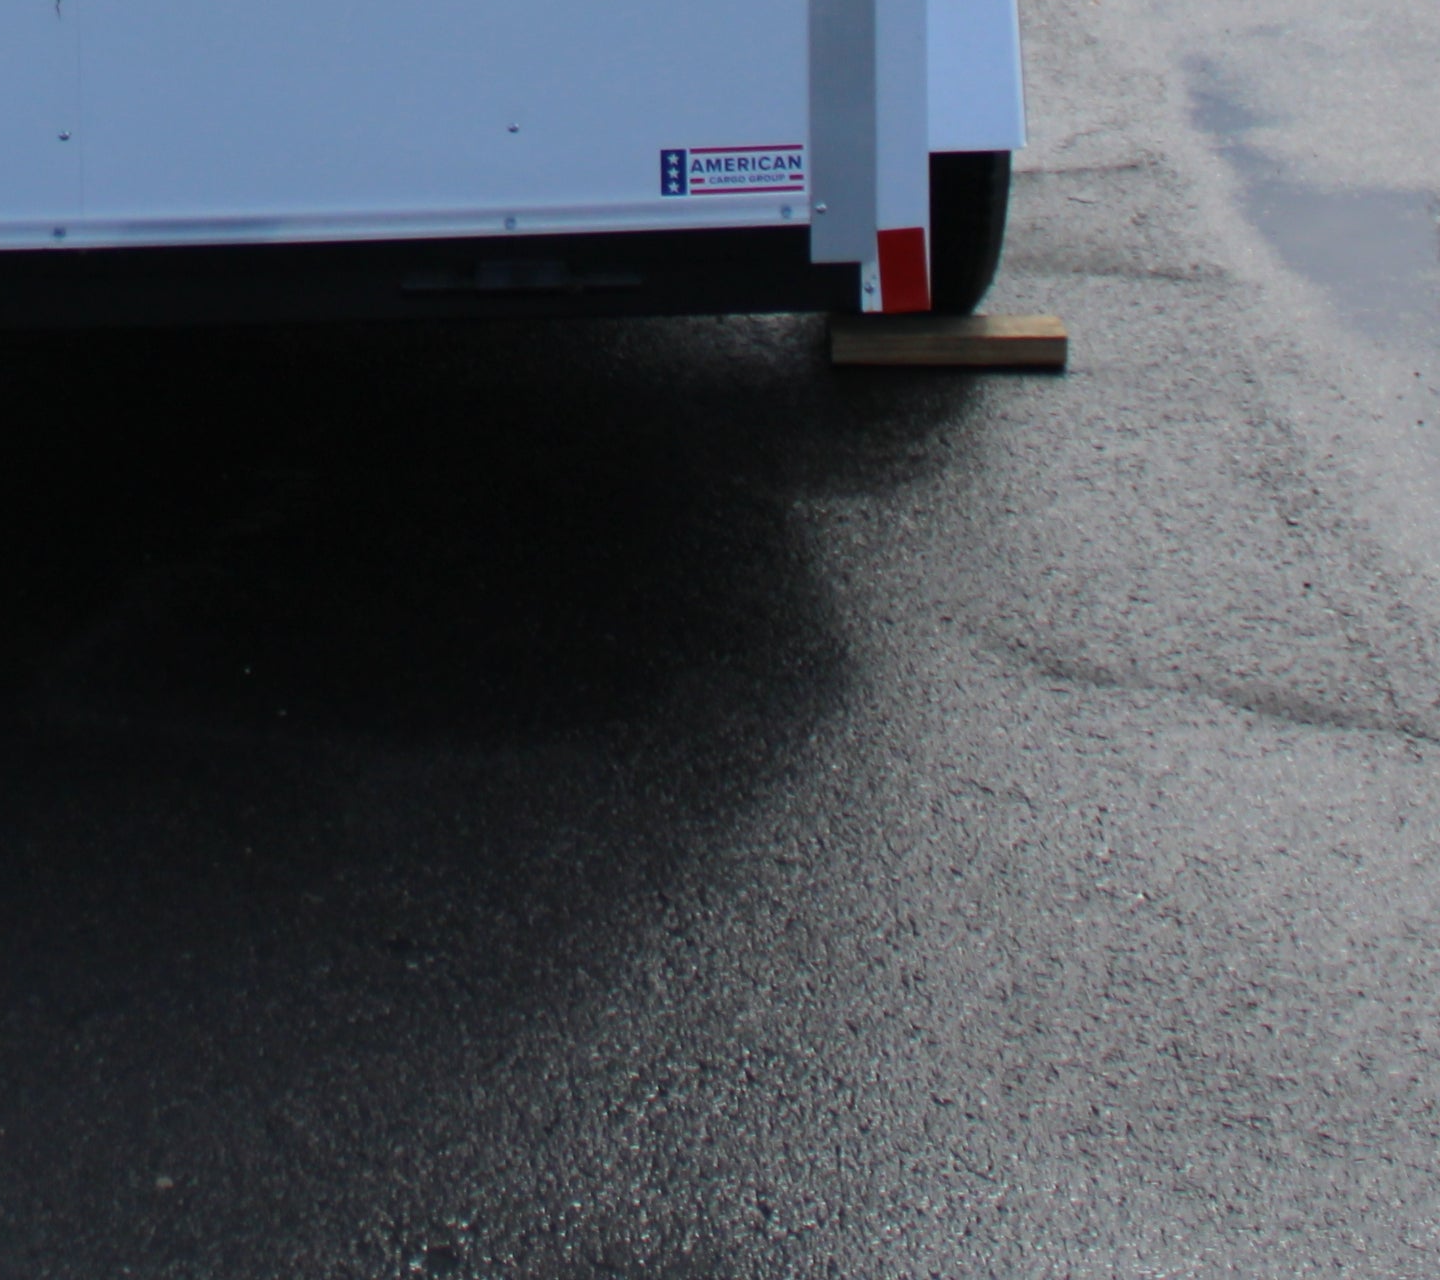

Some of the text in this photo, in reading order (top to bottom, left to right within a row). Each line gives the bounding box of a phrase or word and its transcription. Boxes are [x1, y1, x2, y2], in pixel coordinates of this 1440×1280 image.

[690, 155, 802, 173] AMERICAN
[709, 173, 786, 185] CARGO GROUP
